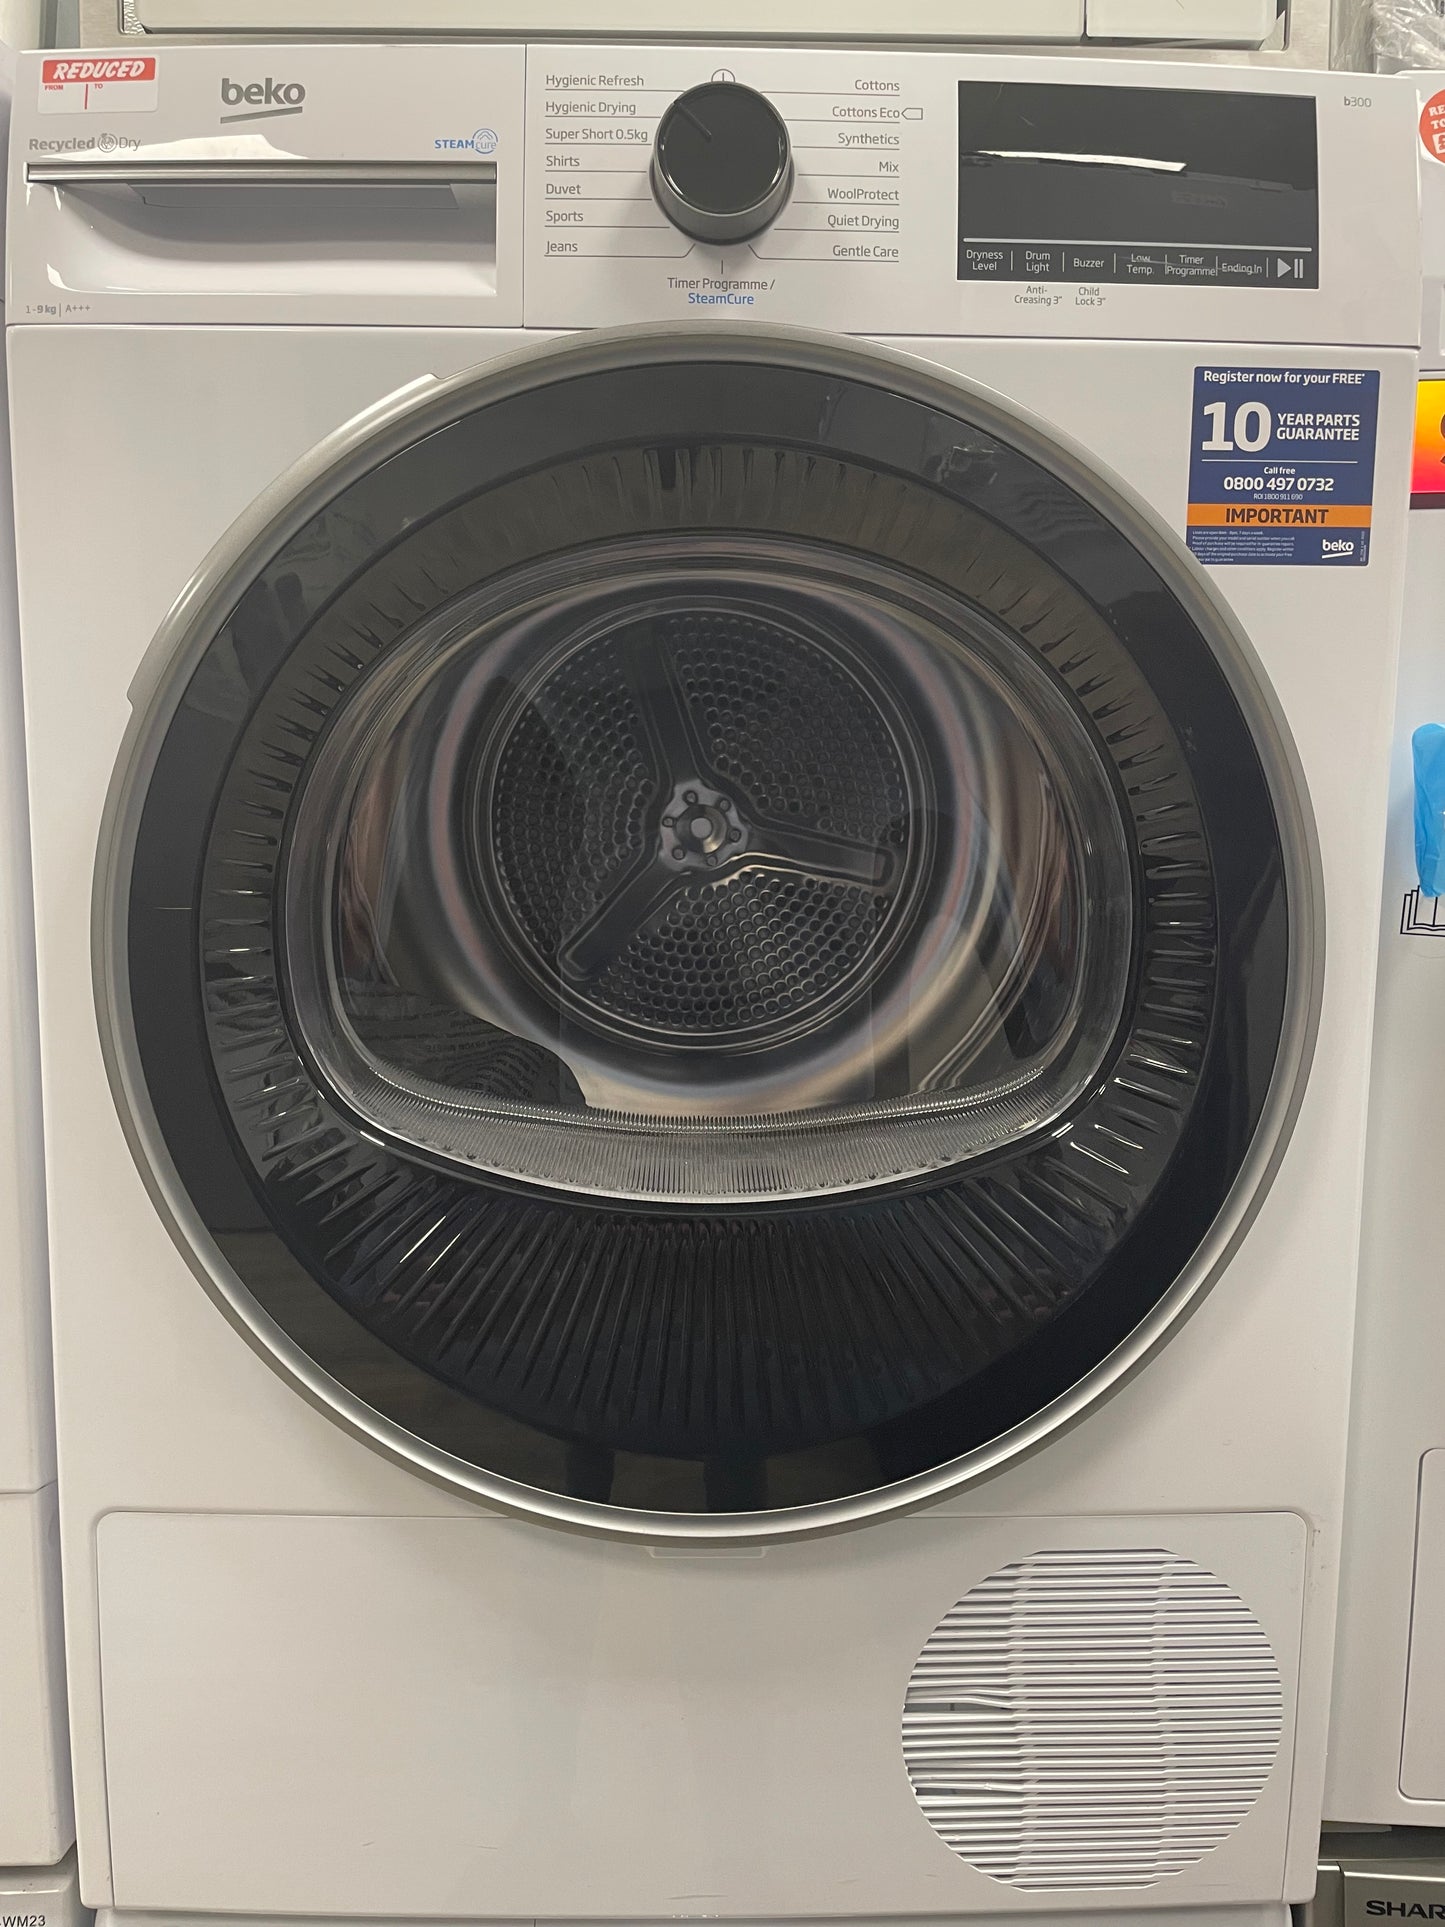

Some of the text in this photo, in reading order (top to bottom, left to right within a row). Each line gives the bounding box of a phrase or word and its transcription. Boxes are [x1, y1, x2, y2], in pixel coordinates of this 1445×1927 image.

[52, 59, 145, 80] REDUCED
[546, 75, 644, 88] Hygienic Refresh
[855, 80, 900, 91] Cottons
[221, 78, 305, 105] beko
[1344, 96, 1371, 107] b300
[546, 101, 636, 115] Hygienic Drying
[833, 106, 900, 118] Cottons Eco
[546, 128, 647, 142] Super Short 0.5kg
[838, 133, 899, 146] Synthetics
[28, 136, 141, 153] Recycled Dry
[547, 155, 580, 166] Shirts
[879, 161, 898, 172] Mix
[546, 184, 581, 194] Duvet
[828, 188, 899, 200] WoolProtect
[546, 210, 583, 224] Sports
[827, 214, 899, 230] Quiet Drying
[546, 241, 578, 254] Jeans
[833, 245, 898, 257] Gentle Care
[967, 250, 1003, 261] Dryness
[1026, 251, 1050, 260] Drum
[1131, 254, 1150, 262] Low
[1179, 255, 1204, 264] Timer
[973, 260, 997, 270] Level
[1027, 262, 1049, 273] Light
[1074, 258, 1104, 268] Buzzer
[1222, 263, 1262, 274] Ending In
[1127, 265, 1154, 275] Temp.
[1167, 265, 1216, 277] Programme
[667, 277, 700, 288] Timer
[703, 278, 767, 292] Programme
[1026, 286, 1047, 294] Anti-
[1079, 287, 1099, 296] Child
[688, 293, 754, 304] SteamCure
[1015, 295, 1051, 306] Creasing
[1076, 297, 1095, 305] Lock
[65, 304, 90, 313] A+++
[1204, 371, 1254, 384] Register
[1256, 374, 1282, 382] now
[1284, 372, 1302, 383] for
[1303, 375, 1330, 385] your
[1277, 413, 1360, 427] YEAR PARTS
[1202, 401, 1272, 452] 10
[1277, 427, 1359, 440] GUARANTEE
[1224, 477, 1334, 491] 0800 497 0732
[1226, 508, 1329, 523] IMPORTANT
[1323, 539, 1354, 551] beko
[0, 1915, 46, 1927] WM23
